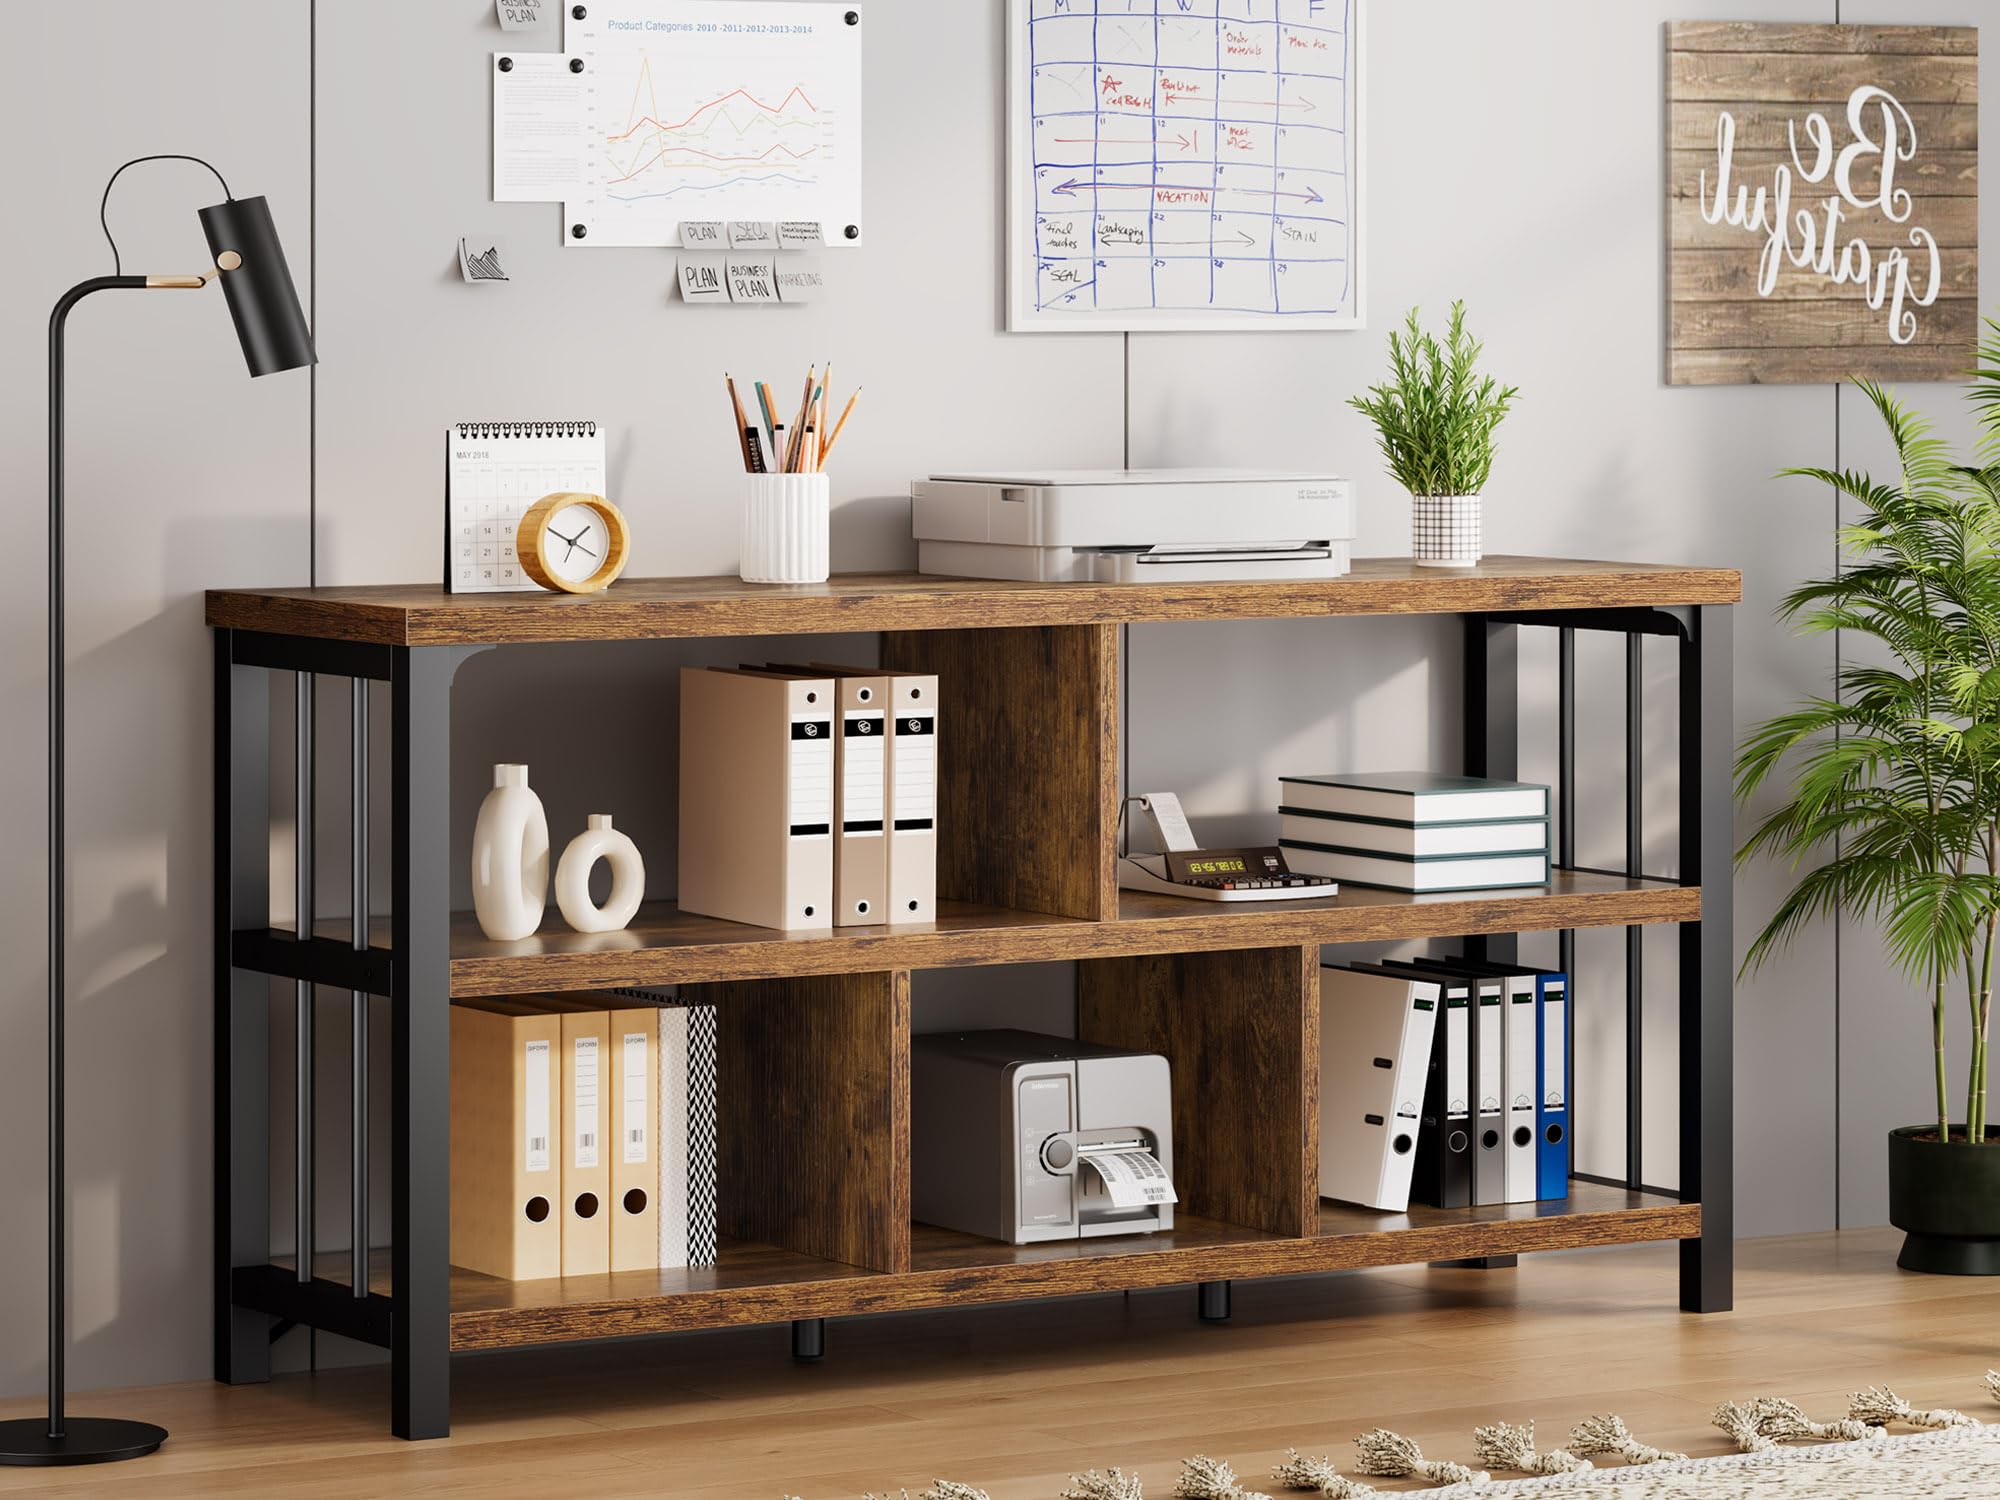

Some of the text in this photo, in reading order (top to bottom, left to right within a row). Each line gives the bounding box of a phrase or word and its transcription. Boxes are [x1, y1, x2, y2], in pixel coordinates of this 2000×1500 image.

[506, 9, 536, 22] PLAN
[608, 20, 643, 31] Product
[645, 20, 693, 33] Categories
[696, 24, 718, 32] 2010
[1157, 119, 1166, 127] 12
[1157, 190, 1209, 204] VACATION
[688, 226, 717, 240] PLAN
[1098, 222, 1145, 245] Landscaping
[1282, 227, 1318, 243] STAIN
[685, 266, 718, 288] PLAN
[731, 265, 769, 277] BUSINESS
[1050, 269, 1081, 283] SEAL
[735, 280, 769, 298] PLAN
[456, 451, 471, 459] MAY
[483, 548, 491, 556] 21
[504, 547, 513, 556] 22
